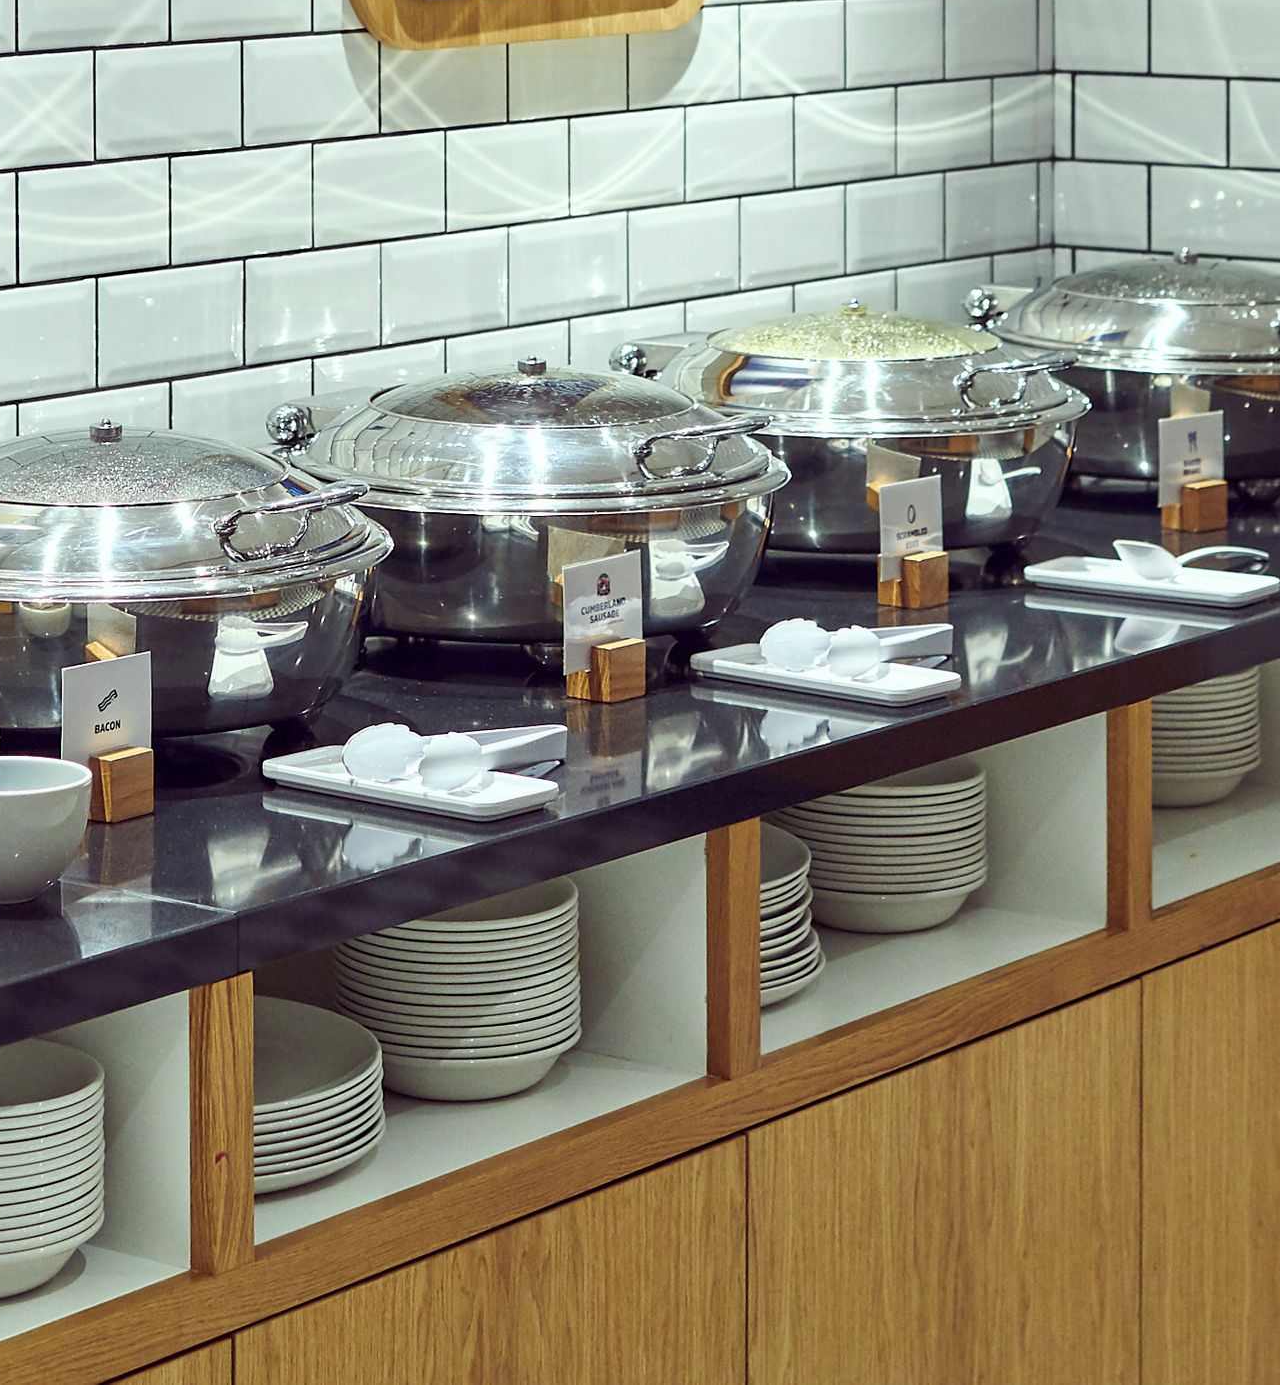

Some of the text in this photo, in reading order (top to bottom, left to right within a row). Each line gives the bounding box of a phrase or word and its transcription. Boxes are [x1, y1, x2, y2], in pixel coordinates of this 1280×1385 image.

[580, 596, 626, 616] CUMBERLAND
[589, 609, 620, 624] SAUSAGE
[94, 719, 121, 735] BACON
